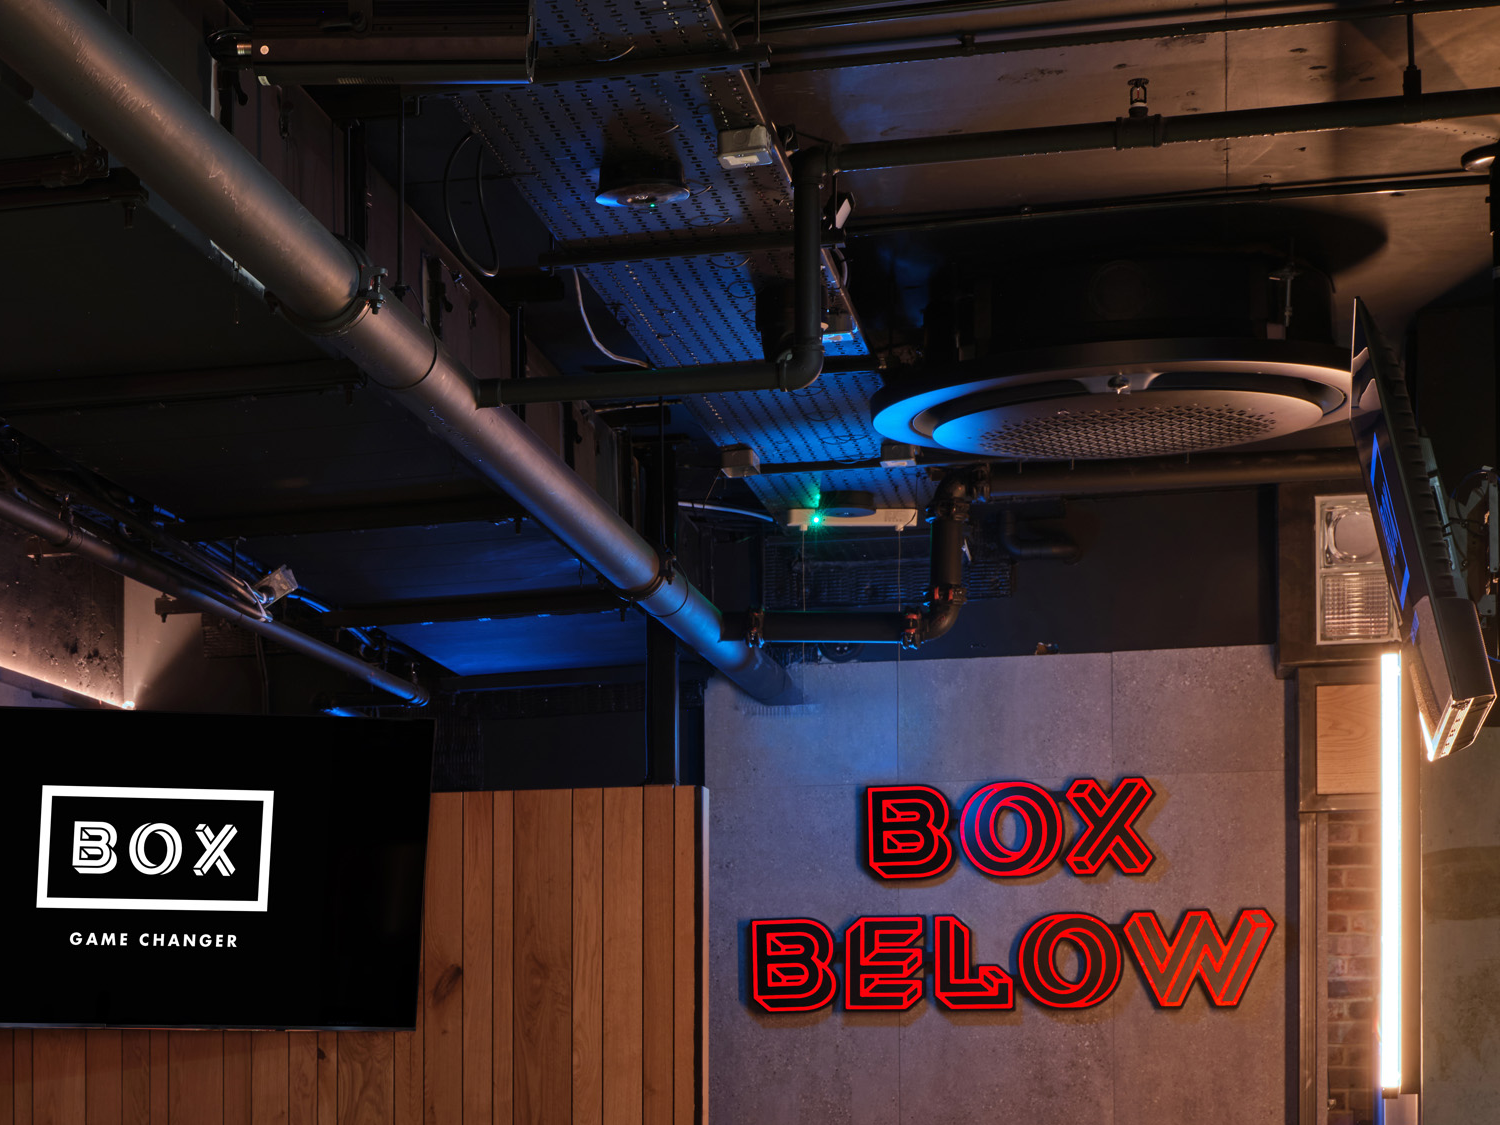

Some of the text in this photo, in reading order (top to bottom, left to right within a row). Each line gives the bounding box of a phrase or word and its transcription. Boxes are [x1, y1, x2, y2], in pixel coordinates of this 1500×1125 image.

[71, 820, 239, 878] BOX
[864, 775, 1156, 881] BOX
[69, 932, 238, 949] GAME CHANGER
[749, 907, 1277, 1013] BELOW
